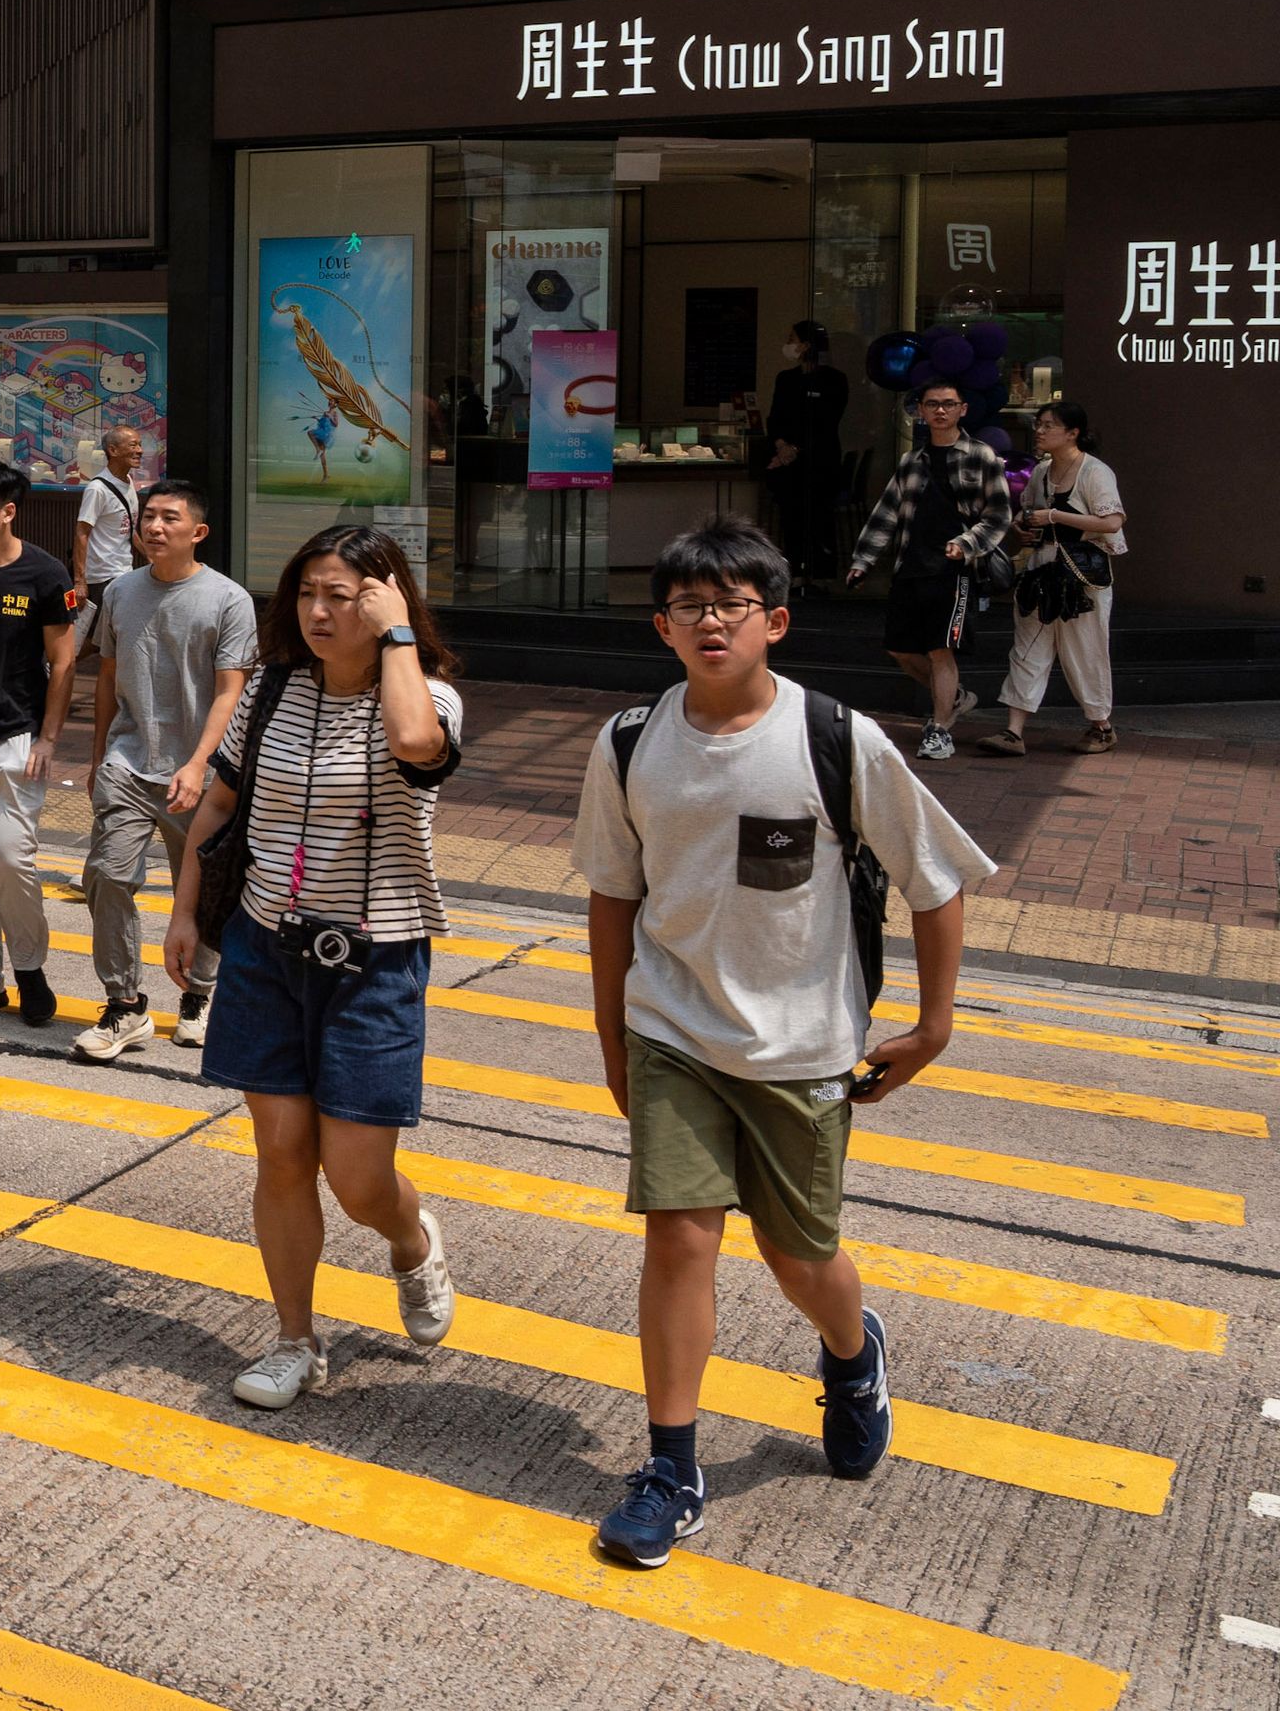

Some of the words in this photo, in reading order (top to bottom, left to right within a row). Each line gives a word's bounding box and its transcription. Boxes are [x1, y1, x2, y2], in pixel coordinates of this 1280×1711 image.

[516, 17, 657, 101] 周生生
[678, 34, 781, 91] Chow
[796, 25, 890, 92] Sang
[905, 18, 1005, 87] Sang
[491, 236, 603, 260] charme
[319, 256, 351, 270] LOVE
[1118, 333, 1175, 363] Chow
[1183, 331, 1234, 368] Sang
[1241, 331, 1280, 364] San
[2, 594, 30, 609] 中国
[2, 607, 26, 617] CHINA
